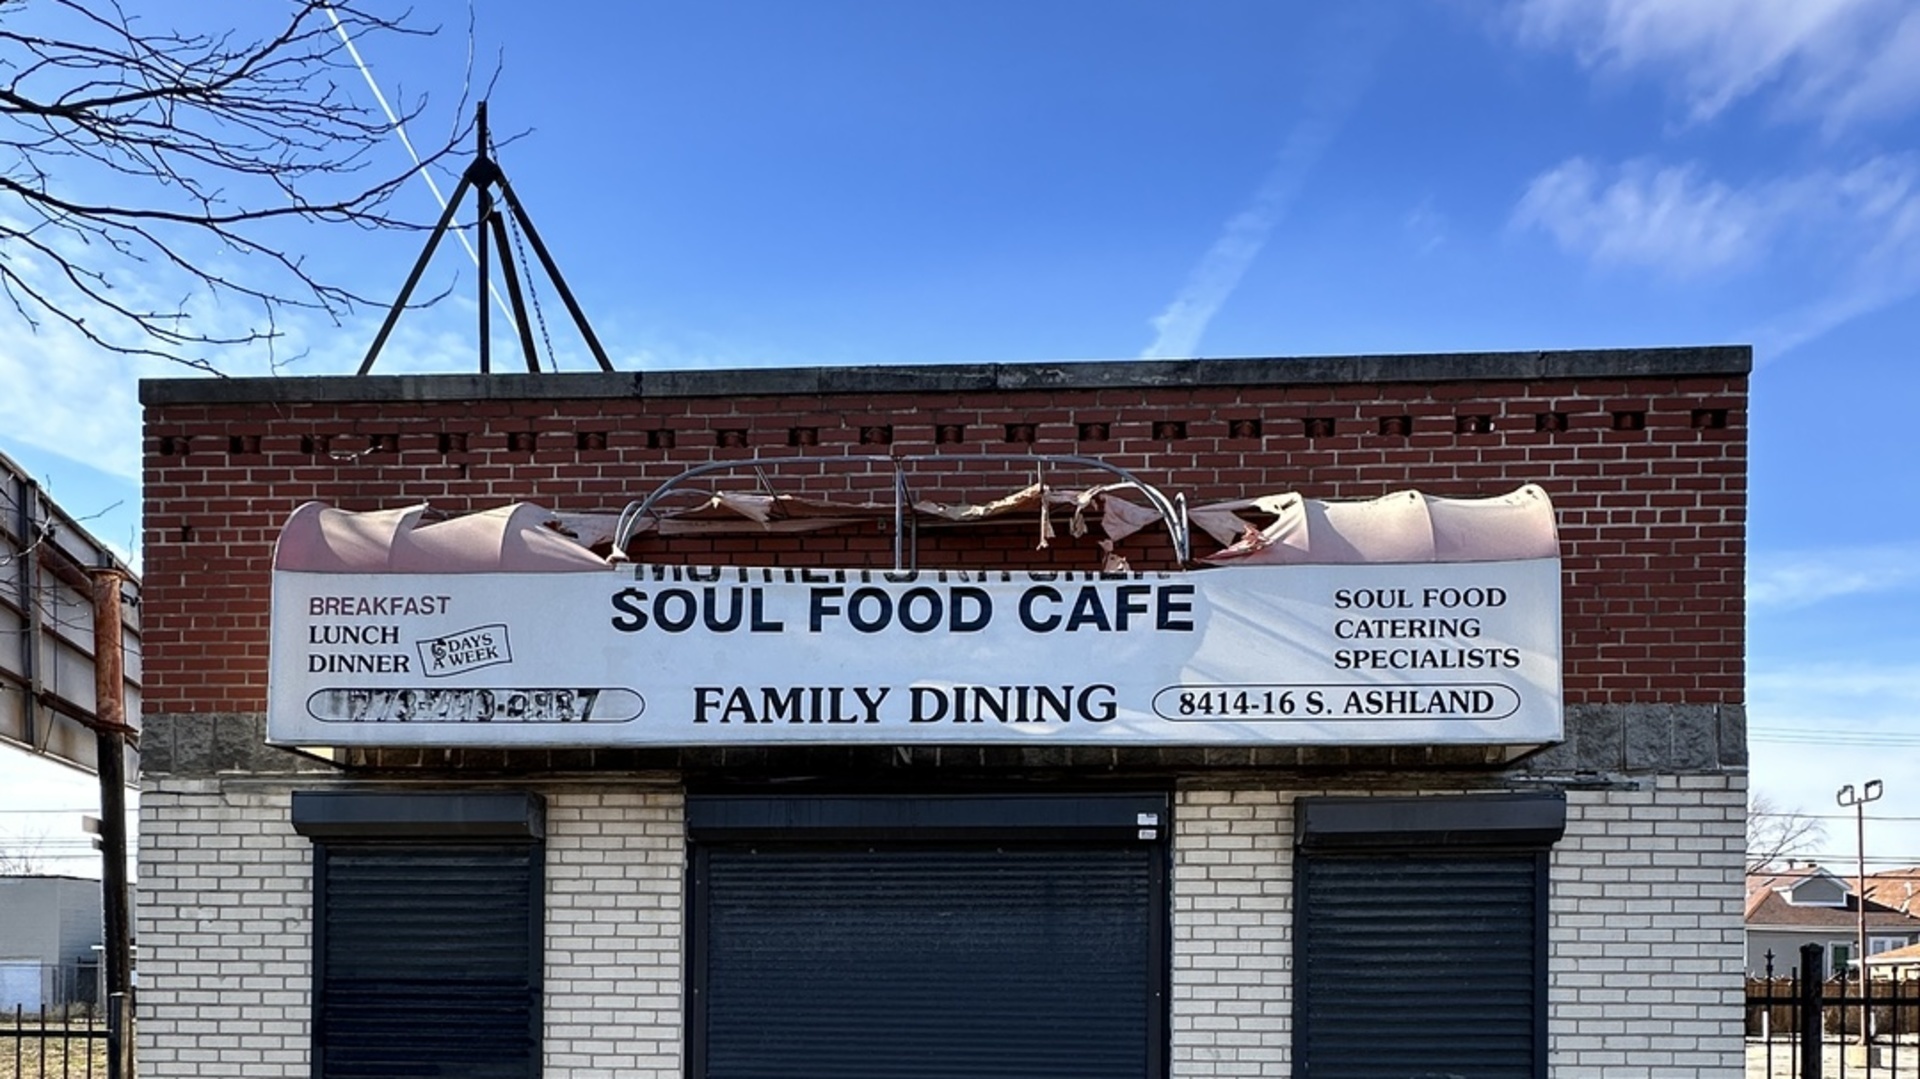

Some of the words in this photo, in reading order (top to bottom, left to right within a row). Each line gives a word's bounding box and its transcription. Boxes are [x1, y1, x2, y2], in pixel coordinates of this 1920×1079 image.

[309, 596, 451, 616] BREAKFAST
[611, 587, 784, 632] SOUL
[809, 586, 993, 632] FOOD
[1018, 584, 1195, 631] CAFE
[1334, 588, 1414, 609] SOUL
[1422, 587, 1507, 608] FOOD
[308, 625, 400, 645] LUNCH
[1334, 617, 1481, 639] CATERING
[448, 633, 493, 653] DAYS
[308, 653, 411, 673] DINNER
[448, 646, 499, 666] WEEK
[1334, 648, 1521, 669] SPECIALISTS
[692, 686, 891, 723] FAMILY
[908, 684, 1118, 723] DINING
[1178, 690, 1296, 716] 8414-16
[1305, 690, 1333, 715] S.
[1343, 690, 1494, 715] ASHLAND
